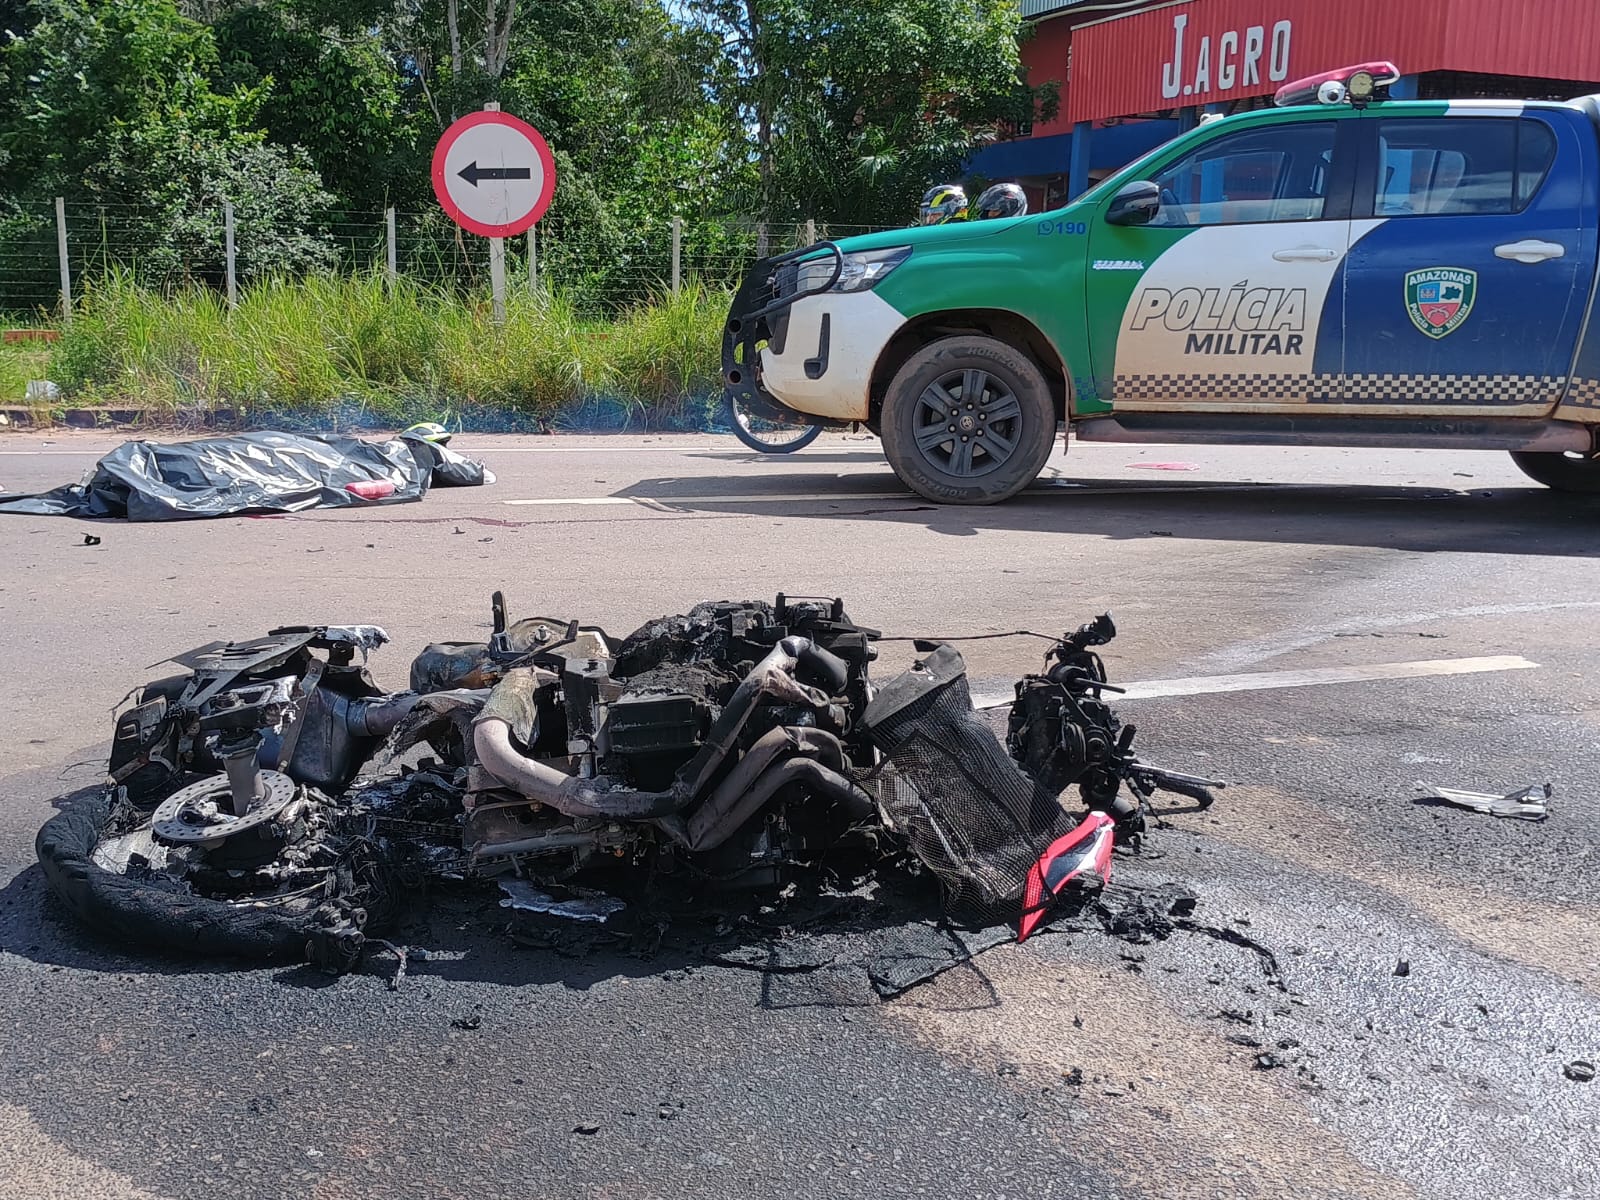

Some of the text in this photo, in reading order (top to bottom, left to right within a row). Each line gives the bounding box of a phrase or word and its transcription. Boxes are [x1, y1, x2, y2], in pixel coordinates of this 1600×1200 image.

[1162, 13, 1292, 99] J.AGRO
[1055, 222, 1086, 235] 190
[1408, 271, 1472, 286] AMAZONAS
[1129, 279, 1307, 331] POLÍCIA
[1446, 303, 1469, 329] Militar
[1184, 333, 1304, 355] MILITAR
